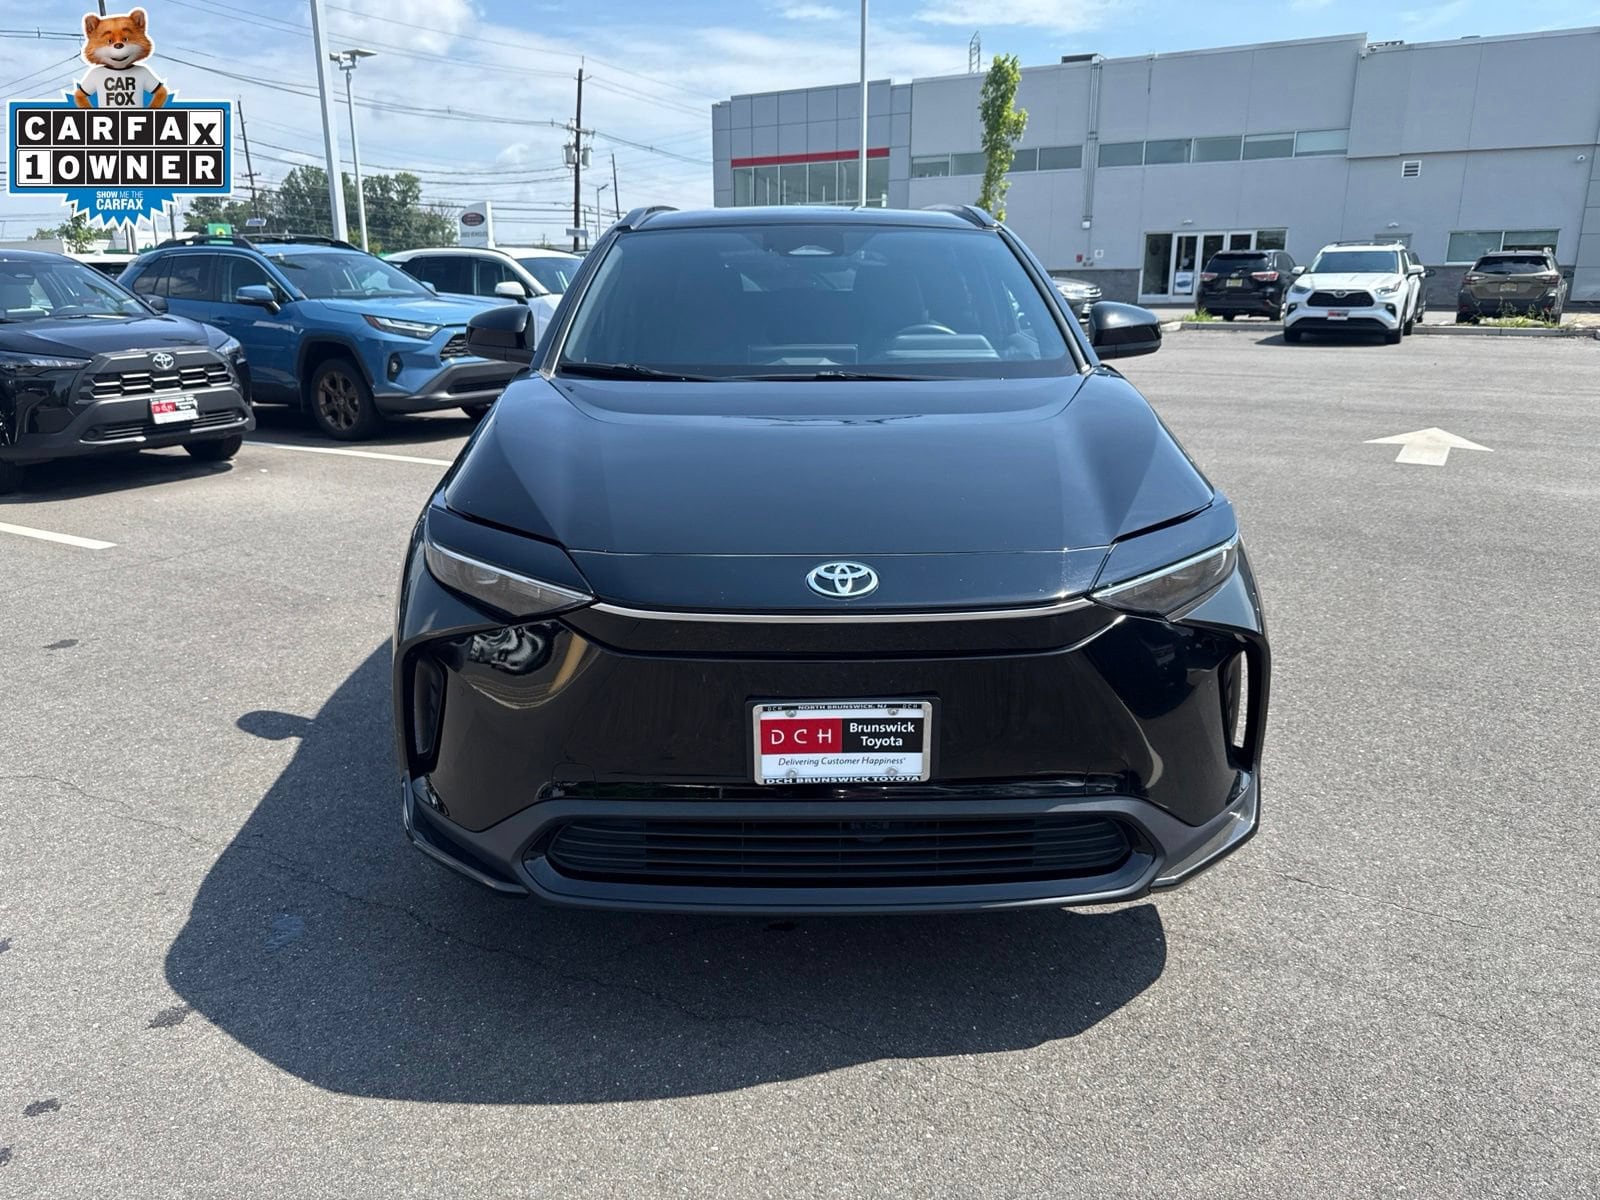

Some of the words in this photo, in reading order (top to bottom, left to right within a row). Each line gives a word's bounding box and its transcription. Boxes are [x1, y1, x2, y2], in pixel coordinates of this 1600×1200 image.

[849, 721, 915, 733] Brunswick
[861, 735, 903, 749] Toyota
[778, 757, 820, 767] Delivering
[821, 756, 860, 766] Customer
